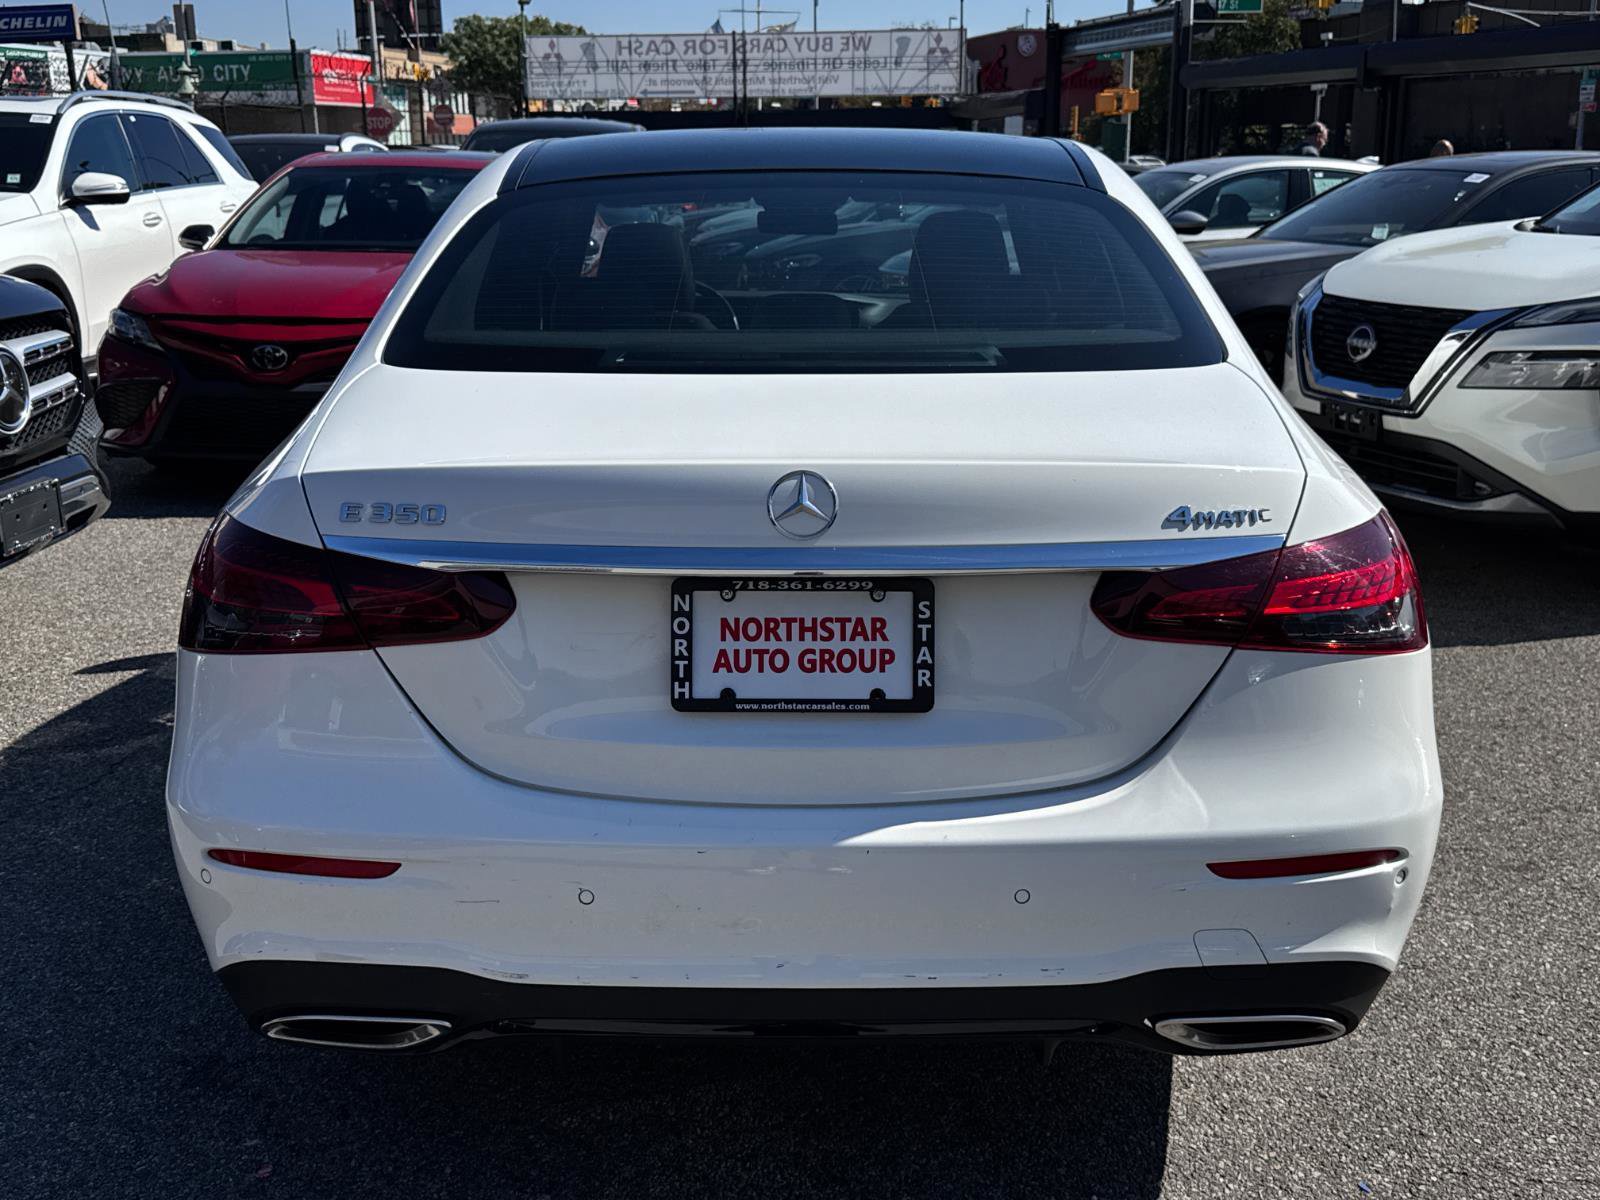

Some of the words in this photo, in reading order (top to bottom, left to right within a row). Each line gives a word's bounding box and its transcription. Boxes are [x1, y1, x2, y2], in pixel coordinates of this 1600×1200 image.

[213, 64, 250, 82] CITY
[367, 116, 392, 129] STOP
[339, 502, 363, 523] E
[369, 502, 446, 525] 350
[1160, 505, 1272, 532] 4MATIC
[732, 580, 874, 590] 718-361-6299
[720, 617, 889, 642] NORTHSTAR
[672, 593, 690, 699] NORTH
[917, 600, 932, 687] STAR
[712, 648, 790, 673] AUTO
[797, 648, 896, 673] GROUP
[735, 701, 871, 711] www.northstarcarsales.com
